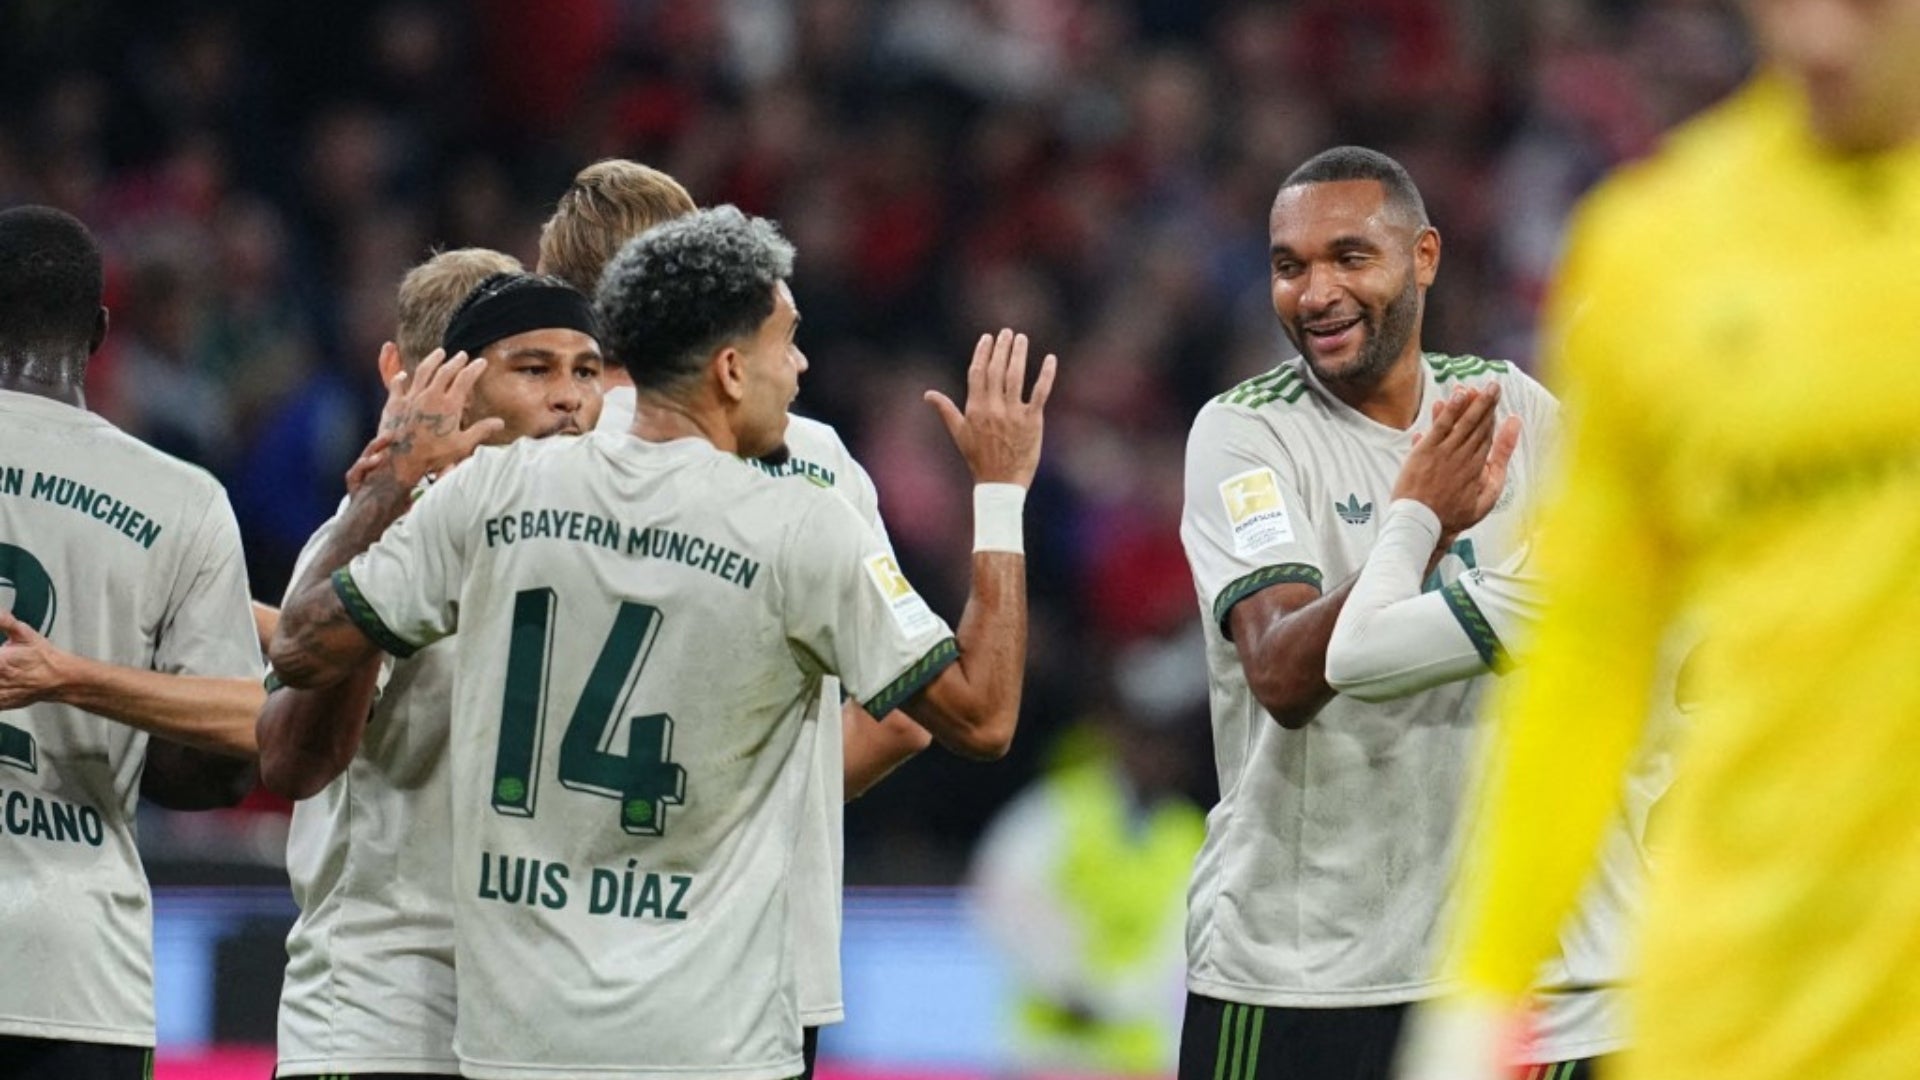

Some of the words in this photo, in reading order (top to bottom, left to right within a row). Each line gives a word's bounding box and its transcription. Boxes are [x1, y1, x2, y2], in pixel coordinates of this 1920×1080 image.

[0, 466, 23, 496] N
[31, 471, 162, 550] MÜNCHEN
[485, 515, 516, 548] FC
[519, 509, 620, 551] BAYERN
[627, 526, 760, 590] MÜNCHEN
[492, 586, 687, 837] 14
[0, 790, 104, 846] CANO
[478, 852, 570, 911] LUIS
[588, 858, 693, 921] DÍAZ
